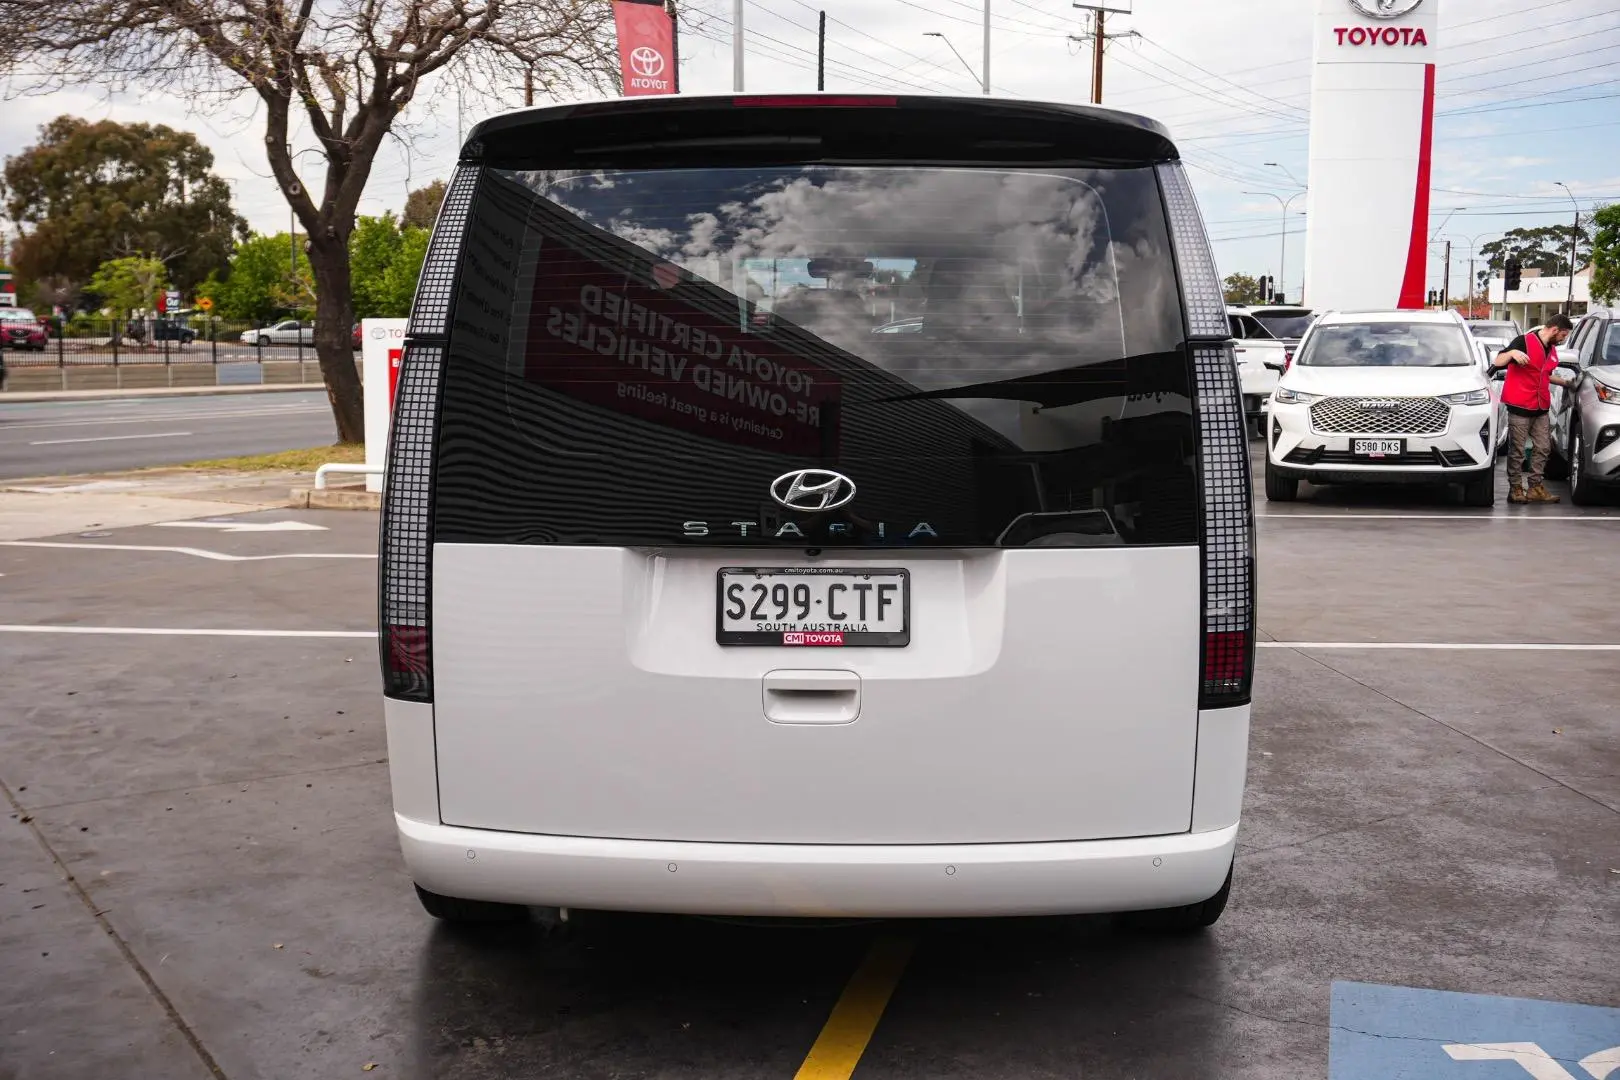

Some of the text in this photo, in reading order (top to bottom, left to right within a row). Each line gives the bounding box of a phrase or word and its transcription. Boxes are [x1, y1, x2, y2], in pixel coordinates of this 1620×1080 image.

[1333, 26, 1428, 46] TOYOTA
[1381, 441, 1399, 452] DKS
[683, 521, 938, 537] STARIA
[784, 567, 844, 575] cmitoyota.com.au
[756, 623, 869, 632] SOUTH AUSTRALIA
[785, 634, 842, 643] CMI TOYOTA
